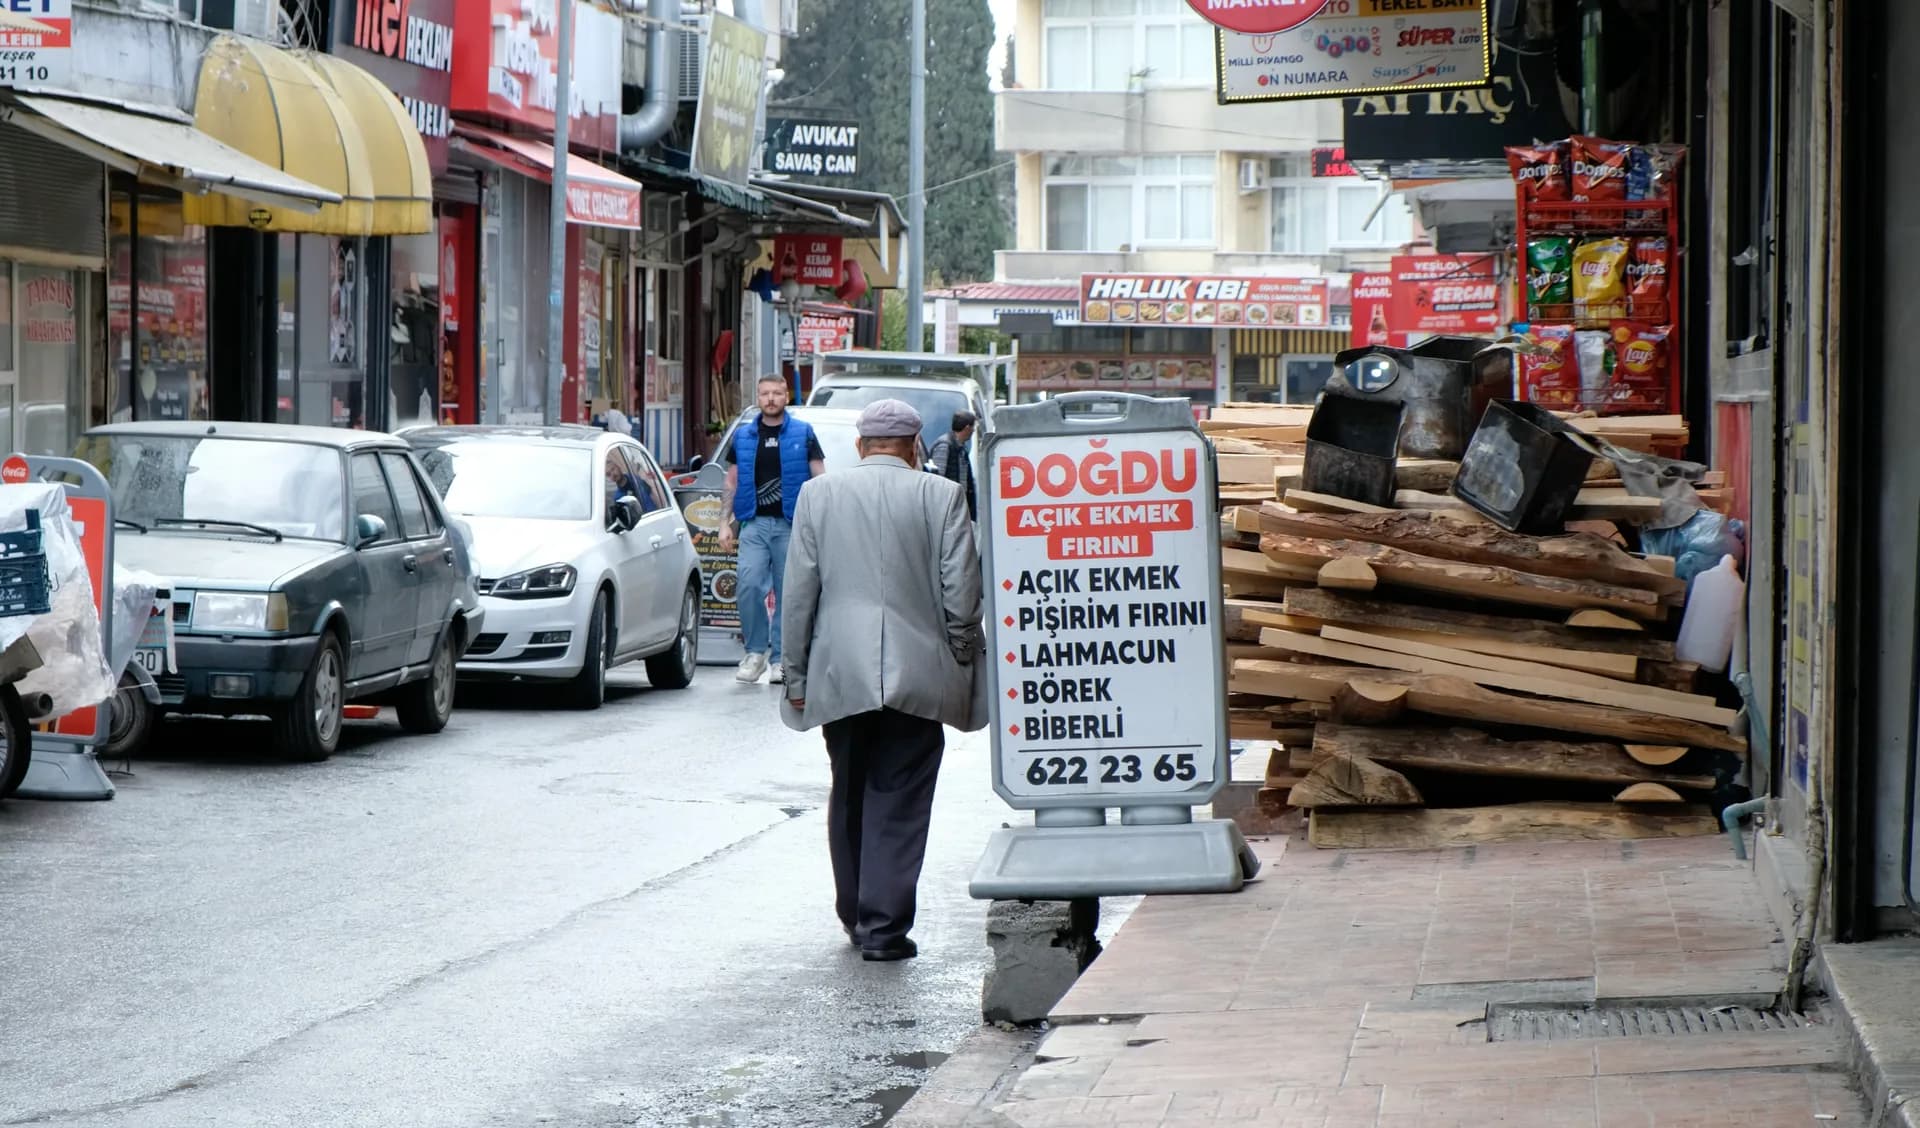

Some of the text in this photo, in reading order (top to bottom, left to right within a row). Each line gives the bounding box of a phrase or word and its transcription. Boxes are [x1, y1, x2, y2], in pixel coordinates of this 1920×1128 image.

[406, 15, 453, 73] REKLAM
[1397, 26, 1456, 47] SÜPER
[1458, 34, 1481, 44] LOTO
[0, 51, 36, 62] EŞER
[1257, 54, 1304, 65] PİYANGO
[26, 66, 48, 80] 10
[1284, 71, 1349, 85] NUMARA
[791, 124, 858, 147] AVUKAT
[775, 152, 857, 176] SAVAŞ CAN
[1573, 160, 1625, 178] Doritos
[803, 266, 834, 279] SALONU
[1627, 263, 1666, 276] oritos
[26, 276, 73, 310] TARSUS
[1088, 278, 1193, 300] HALUK
[999, 439, 1198, 499] DOĞDU
[1019, 503, 1181, 533] AÇIK EKMEK
[1061, 535, 1139, 556] FIRINI
[1017, 565, 1181, 602] AÇIK EKMEK
[1018, 597, 1207, 638] PİŞİRİM FIRINI
[1020, 638, 1176, 668] LAHMACUN
[1022, 672, 1113, 704] BÖREK
[1024, 706, 1124, 741] BİBERLİ
[1026, 753, 1197, 785] 622 23 65
